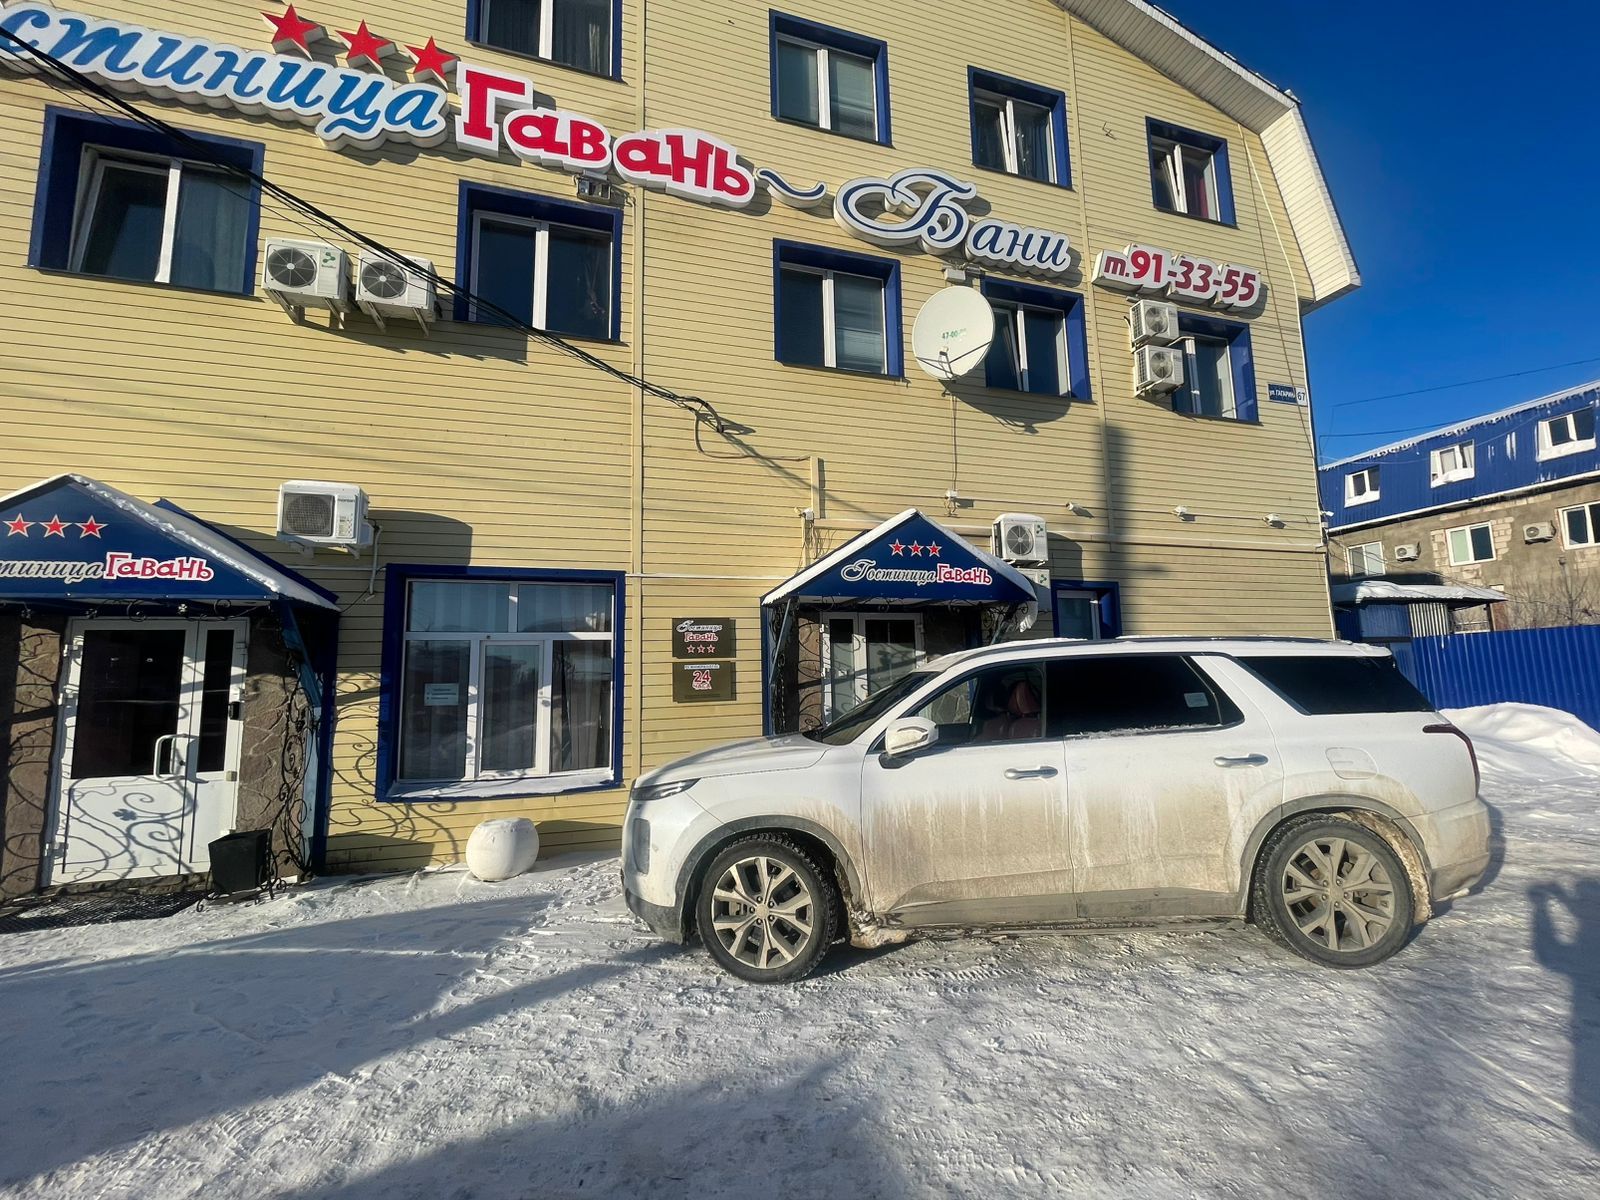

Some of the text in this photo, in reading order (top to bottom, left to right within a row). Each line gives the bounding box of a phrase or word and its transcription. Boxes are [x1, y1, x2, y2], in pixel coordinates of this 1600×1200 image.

[464, 69, 750, 197] Гавань
[842, 173, 1066, 267] Бани
[106, 554, 212, 579] Гавань
[842, 560, 991, 584] Гостиница Гавань
[685, 633, 718, 641] Гавань
[694, 670, 711, 682] 24
